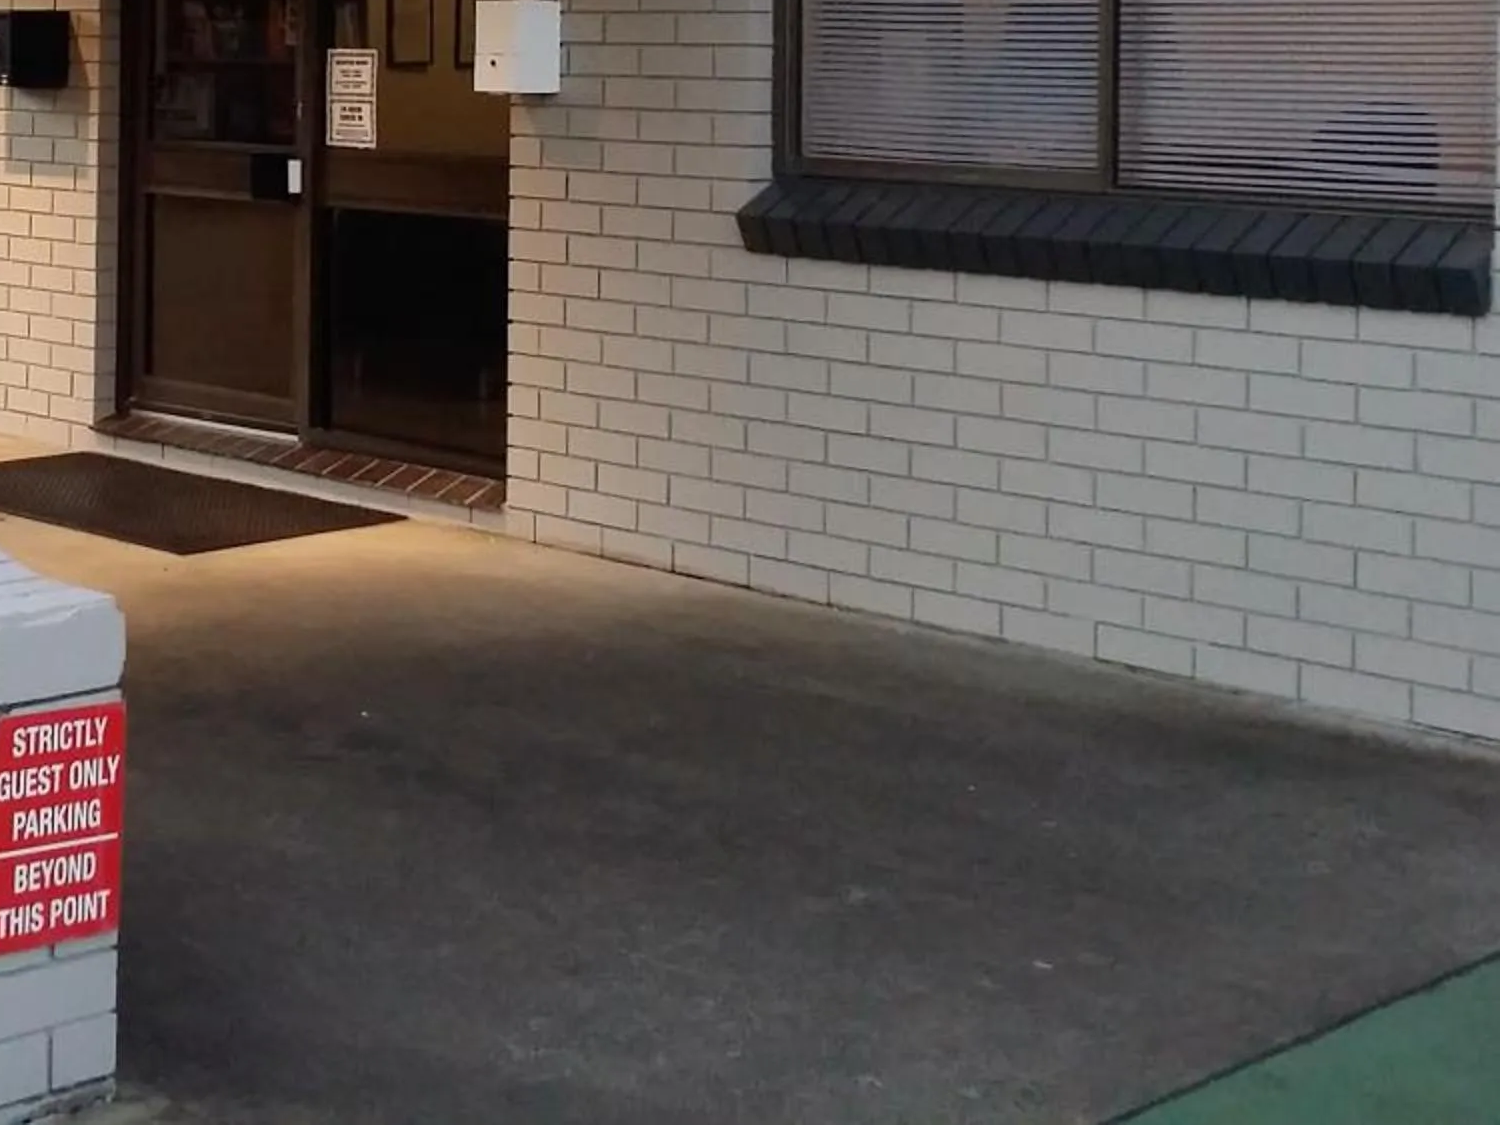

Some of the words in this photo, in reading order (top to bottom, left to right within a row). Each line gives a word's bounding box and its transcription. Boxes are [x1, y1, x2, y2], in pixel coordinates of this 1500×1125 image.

[12, 716, 109, 758] STRICTLY
[69, 755, 121, 791] ONLY
[12, 799, 101, 842] PARKING
[13, 852, 97, 895] BEYOND
[49, 889, 111, 928] POINT
